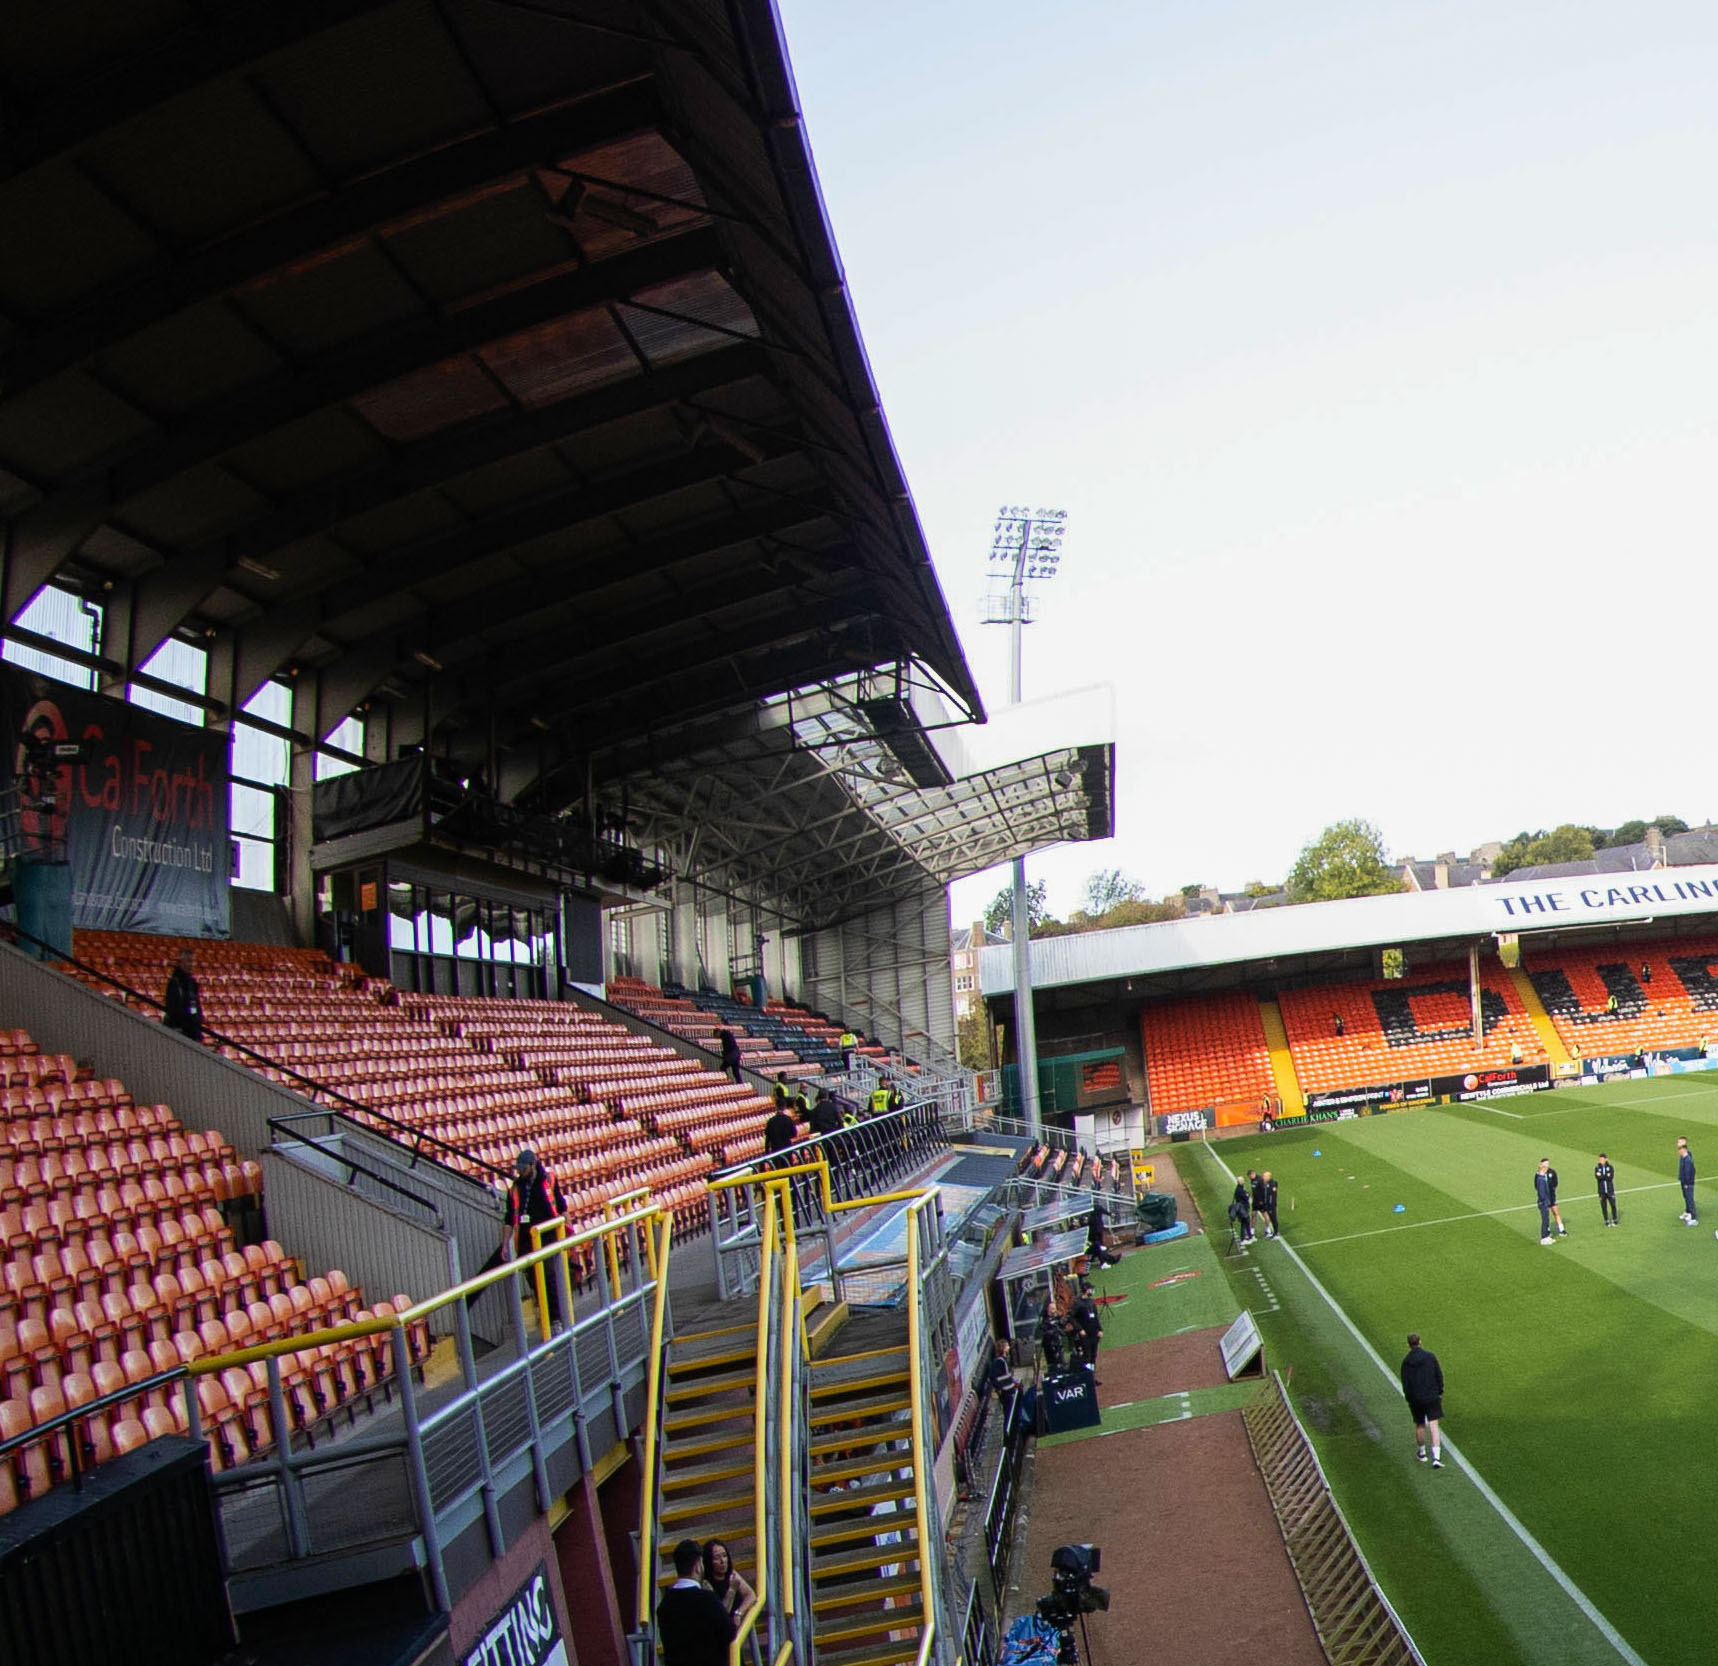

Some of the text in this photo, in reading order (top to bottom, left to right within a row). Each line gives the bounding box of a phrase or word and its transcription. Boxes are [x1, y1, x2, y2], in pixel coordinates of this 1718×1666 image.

[112, 825, 213, 873] Construction Ltd
[1496, 892, 1571, 916] THE
[1166, 1111, 1199, 1125] NEXUS
[1166, 1119, 1207, 1135] SIGNAGE
[1057, 1386, 1084, 1402] VAR
